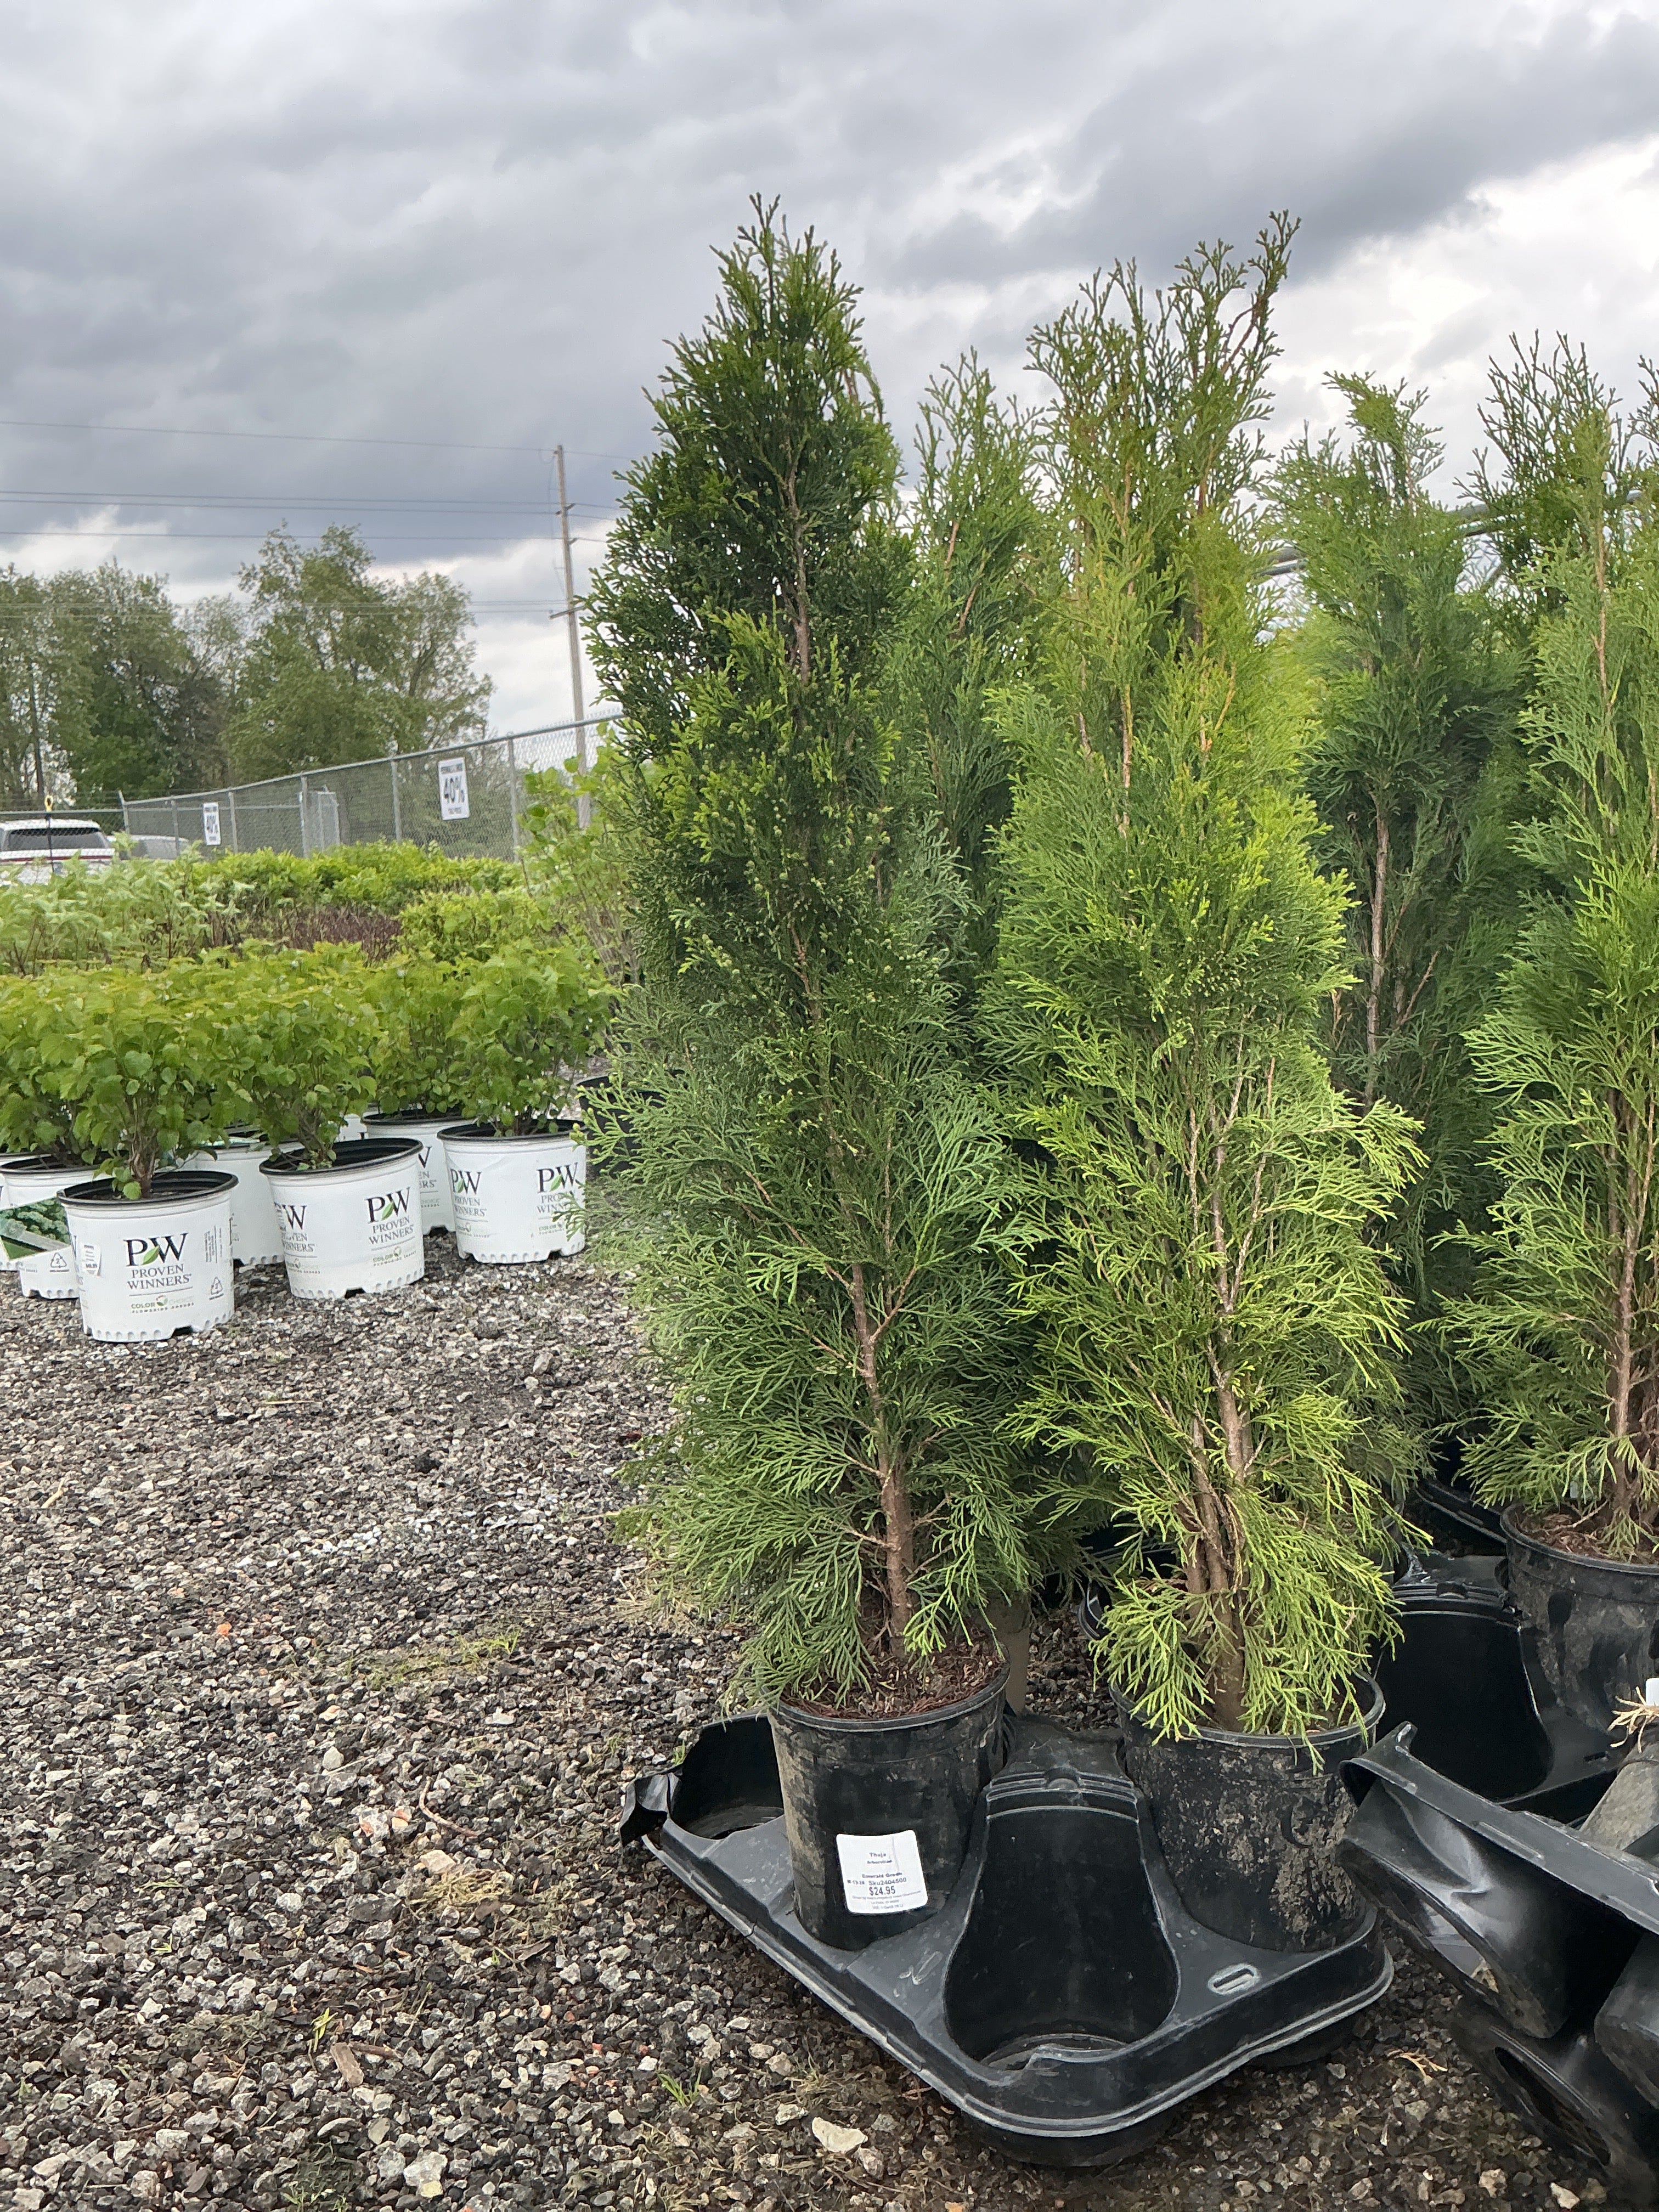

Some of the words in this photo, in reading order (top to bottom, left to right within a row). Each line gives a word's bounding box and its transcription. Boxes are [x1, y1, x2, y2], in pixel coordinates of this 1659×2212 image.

[450, 1168, 483, 1195] PW
[537, 1161, 578, 1193] PW
[364, 1186, 411, 1224] PW
[369, 1224, 414, 1245] WINNERS
[373, 1215, 410, 1234] PROVEN
[123, 1232, 189, 1267] PW
[127, 1273, 190, 1290] WINNERS
[132, 1263, 184, 1279] PROVEN
[868, 1886, 896, 1896] $24.95
